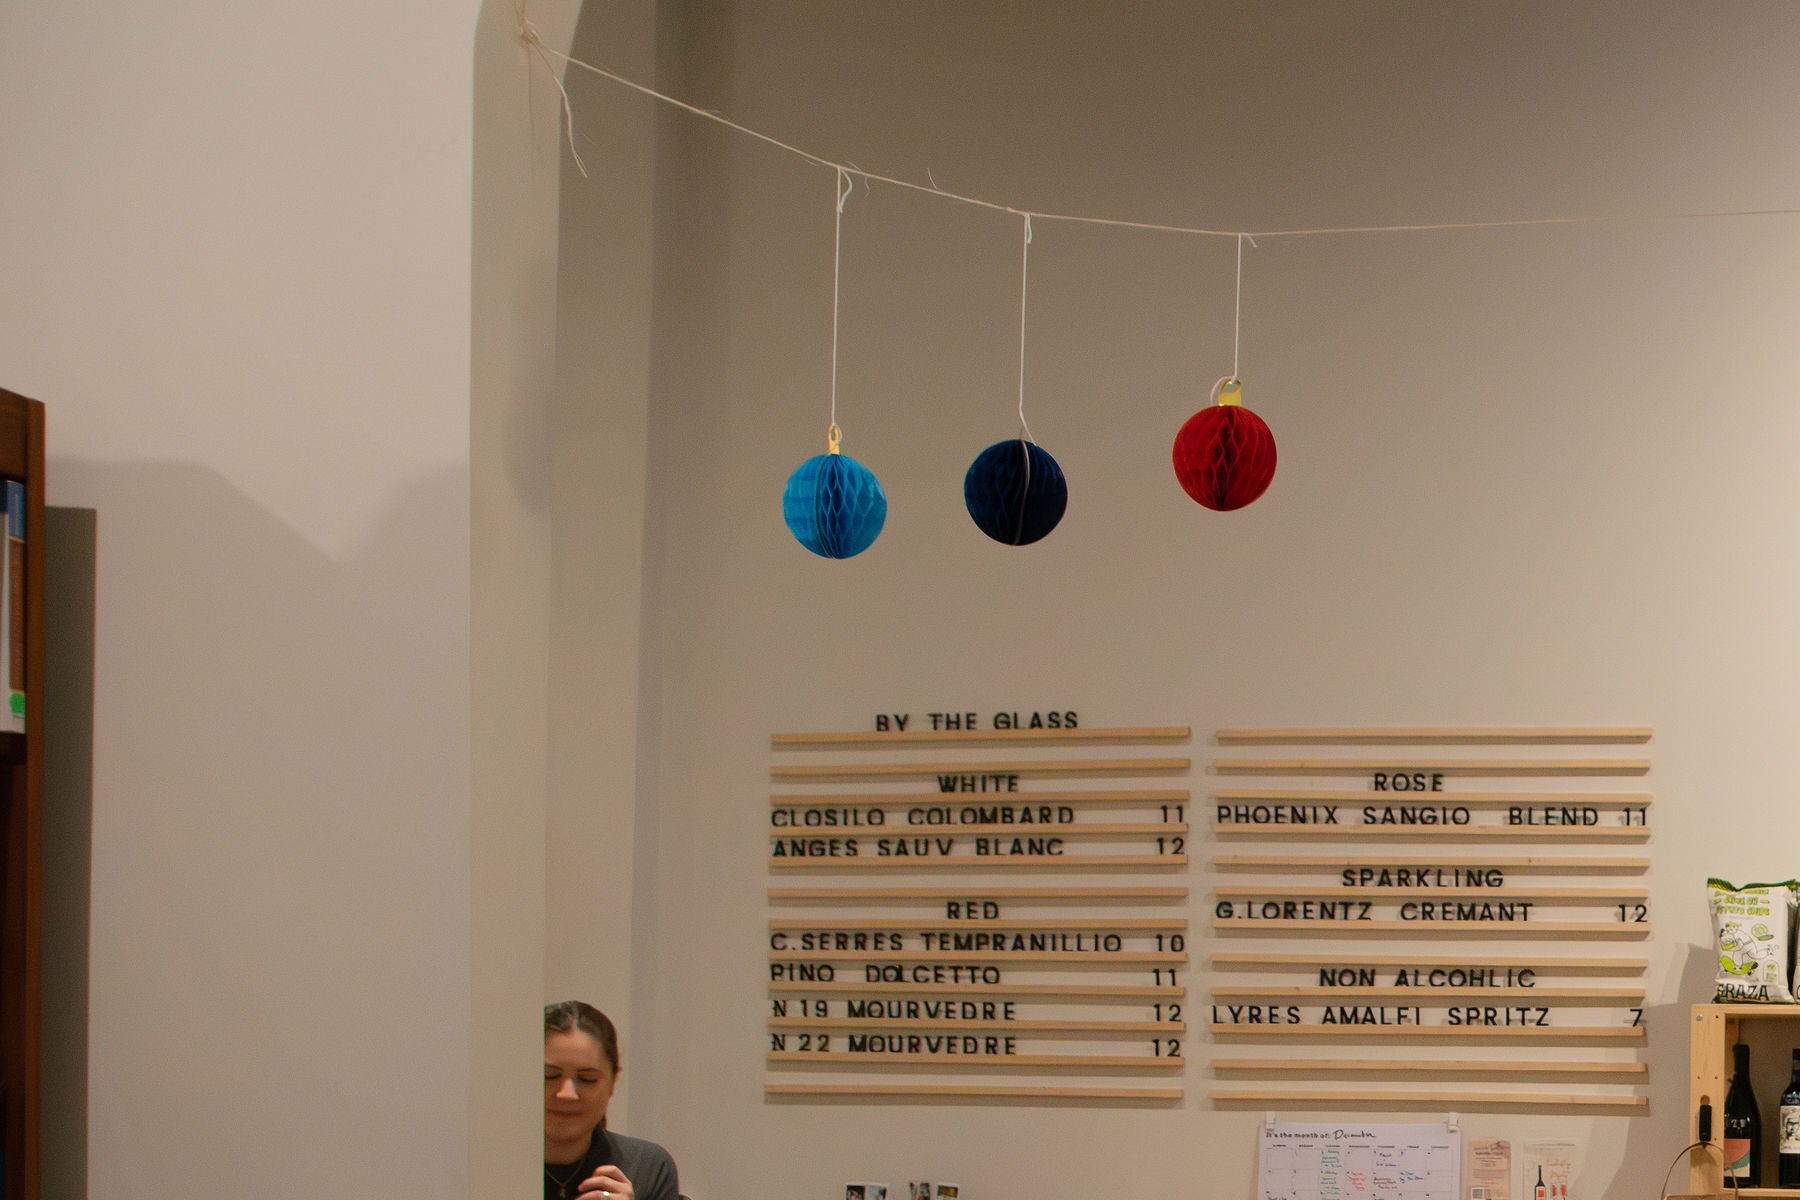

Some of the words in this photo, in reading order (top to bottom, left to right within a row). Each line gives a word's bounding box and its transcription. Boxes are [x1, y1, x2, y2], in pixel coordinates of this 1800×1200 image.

[876, 714, 909, 731] BY
[928, 713, 977, 730] THE
[993, 712, 1078, 730] GLASS
[938, 775, 1019, 793] WHITE
[1374, 773, 1444, 792] ROSE
[771, 809, 885, 827] CLOSILO
[907, 806, 1074, 825] COLOMBARD
[1159, 806, 1185, 823] 11
[1217, 806, 1338, 825] PHOENIX
[1363, 806, 1470, 825] SANGIO
[1509, 807, 1599, 826] BLEND
[1623, 808, 1647, 826] 11
[772, 839, 858, 857] ANGES
[877, 838, 953, 856] SAUV
[975, 838, 1064, 856] BLANC
[1156, 837, 1185, 855] 12
[1342, 869, 1504, 888] SPARKLING
[946, 901, 999, 920] RED
[1215, 901, 1372, 920] G.LORENTZ
[1399, 902, 1534, 922] CREMANT
[1617, 904, 1648, 923] 12
[770, 933, 903, 951] C.SERRES
[920, 933, 1122, 952] TEMPRANILLIO
[1155, 934, 1185, 953] 10
[770, 964, 836, 982] PINO
[866, 965, 1000, 984] DOLCETTO
[1152, 969, 1177, 986] 11
[1320, 969, 1375, 988] NON
[1394, 969, 1536, 988] ALCOHLIC
[772, 1000, 786, 1017] N
[800, 1001, 829, 1018] 19
[848, 1001, 1016, 1021] MOURVEDRE
[1153, 1005, 1182, 1022] 12
[1212, 1006, 1301, 1025] LYRES
[1322, 1006, 1421, 1026] AMALFI
[1448, 1007, 1550, 1027] SPRITZ
[1629, 1008, 1643, 1027] 7
[771, 1034, 786, 1051] N
[799, 1034, 831, 1052] 22
[848, 1035, 1017, 1055] MOURVEDRE
[1153, 1039, 1181, 1058] 12
